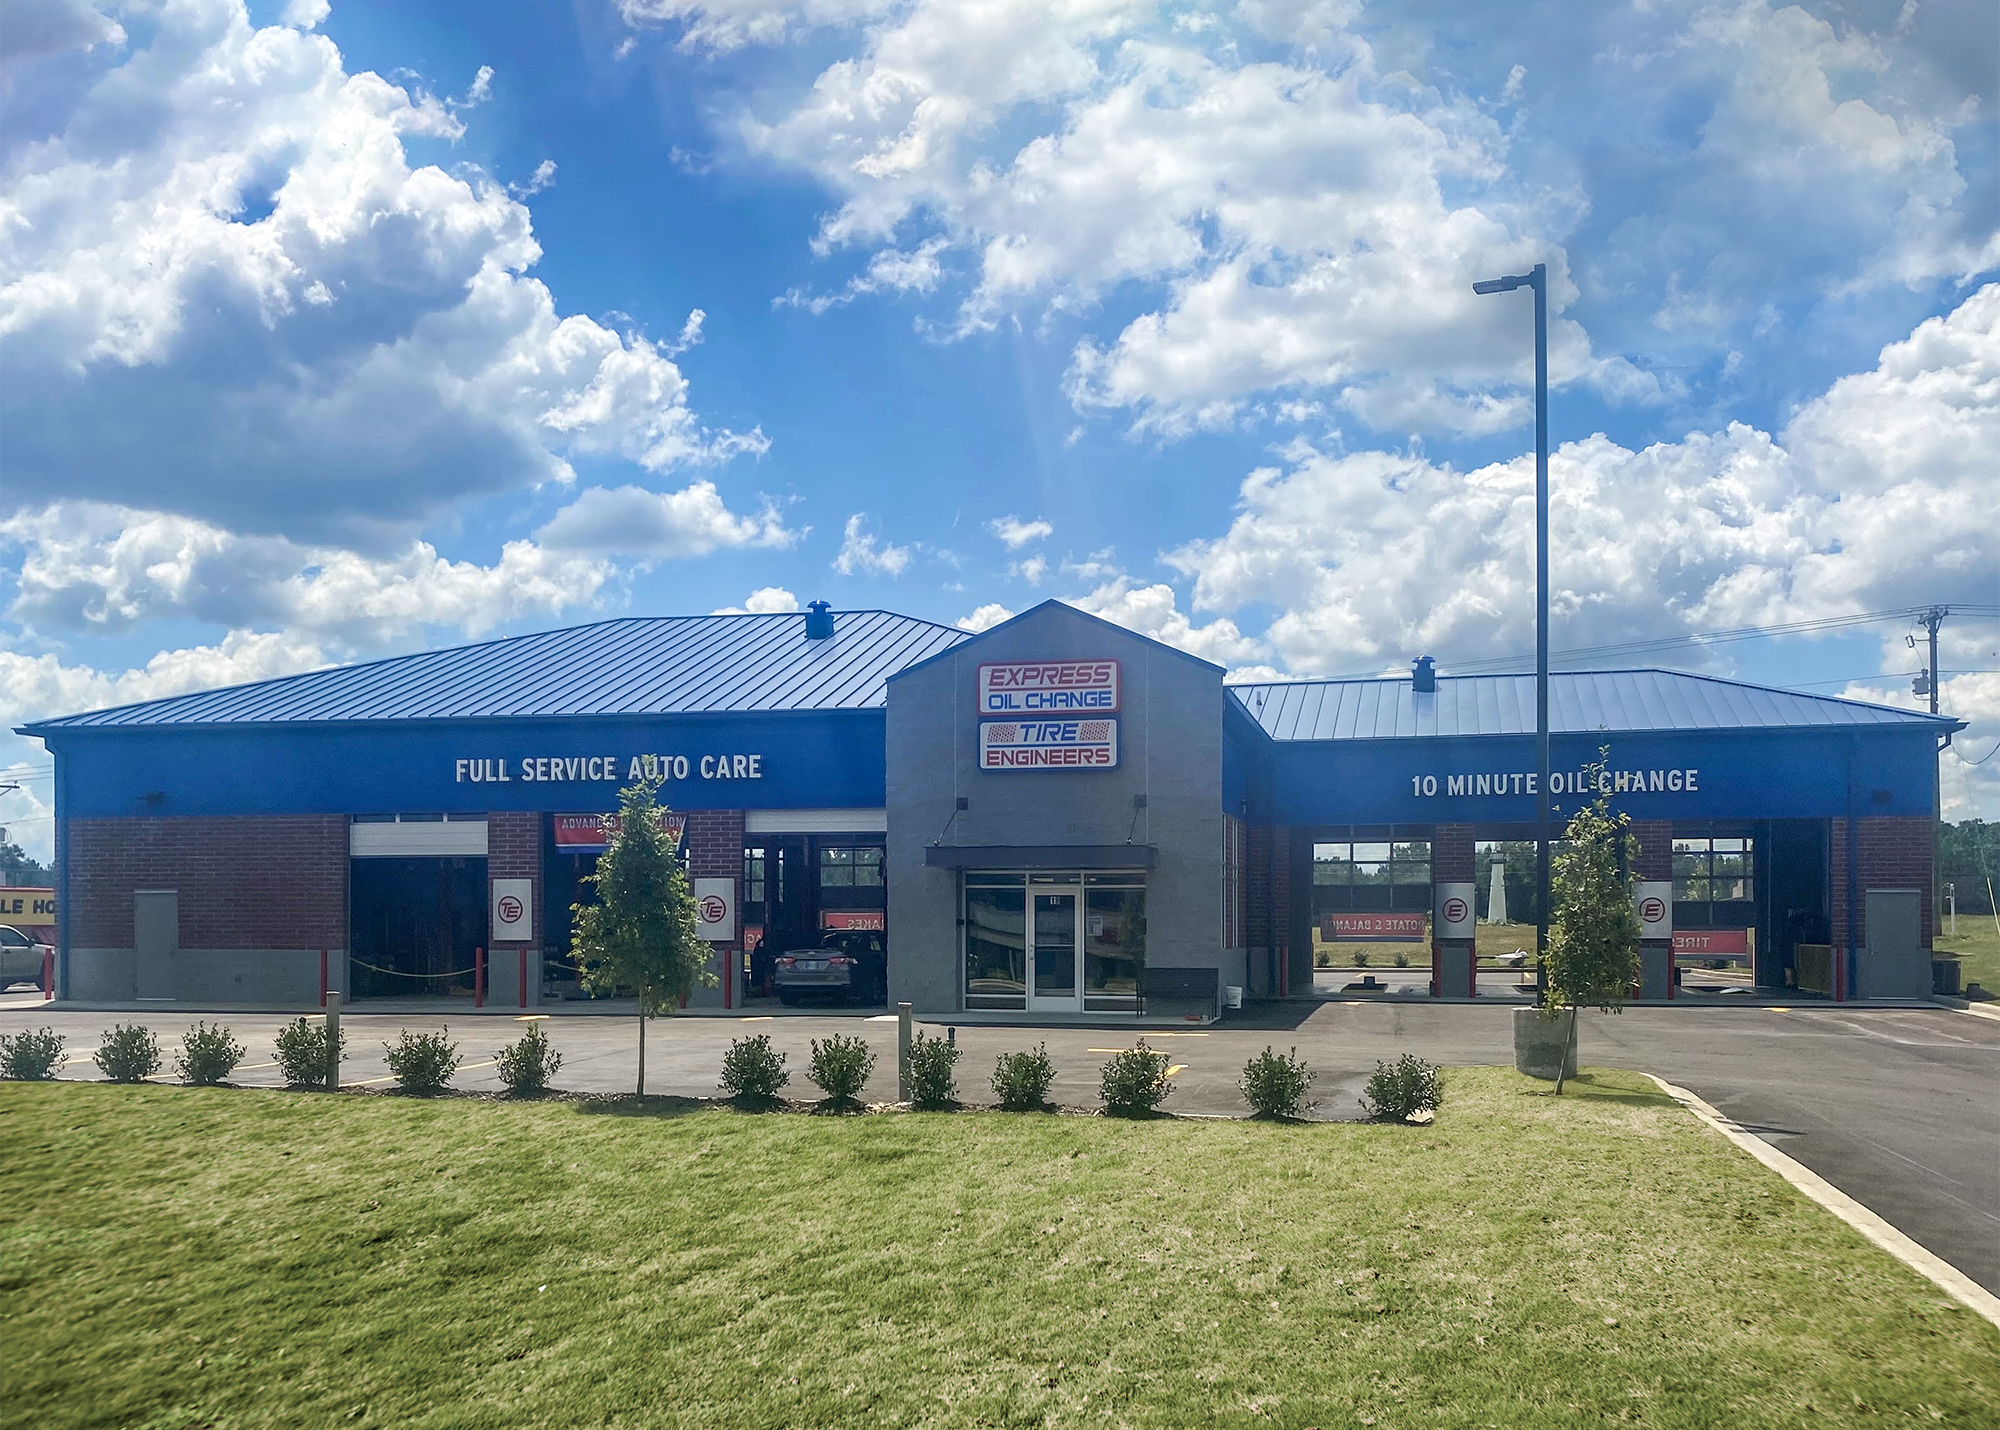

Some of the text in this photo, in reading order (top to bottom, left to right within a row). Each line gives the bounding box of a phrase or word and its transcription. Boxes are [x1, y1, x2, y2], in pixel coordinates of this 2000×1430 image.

[989, 665, 1112, 686] EXPRESS
[988, 691, 1112, 710] OIL CHANGE
[1020, 723, 1079, 742] TIRE
[986, 748, 1110, 766] ENGINEERS
[456, 755, 762, 782] FULL SERVICE AUTO CARE
[1412, 770, 1699, 797] 10 MINUTE OIL CHANGE
[1447, 905, 1463, 916] E
[1645, 904, 1661, 917] E
